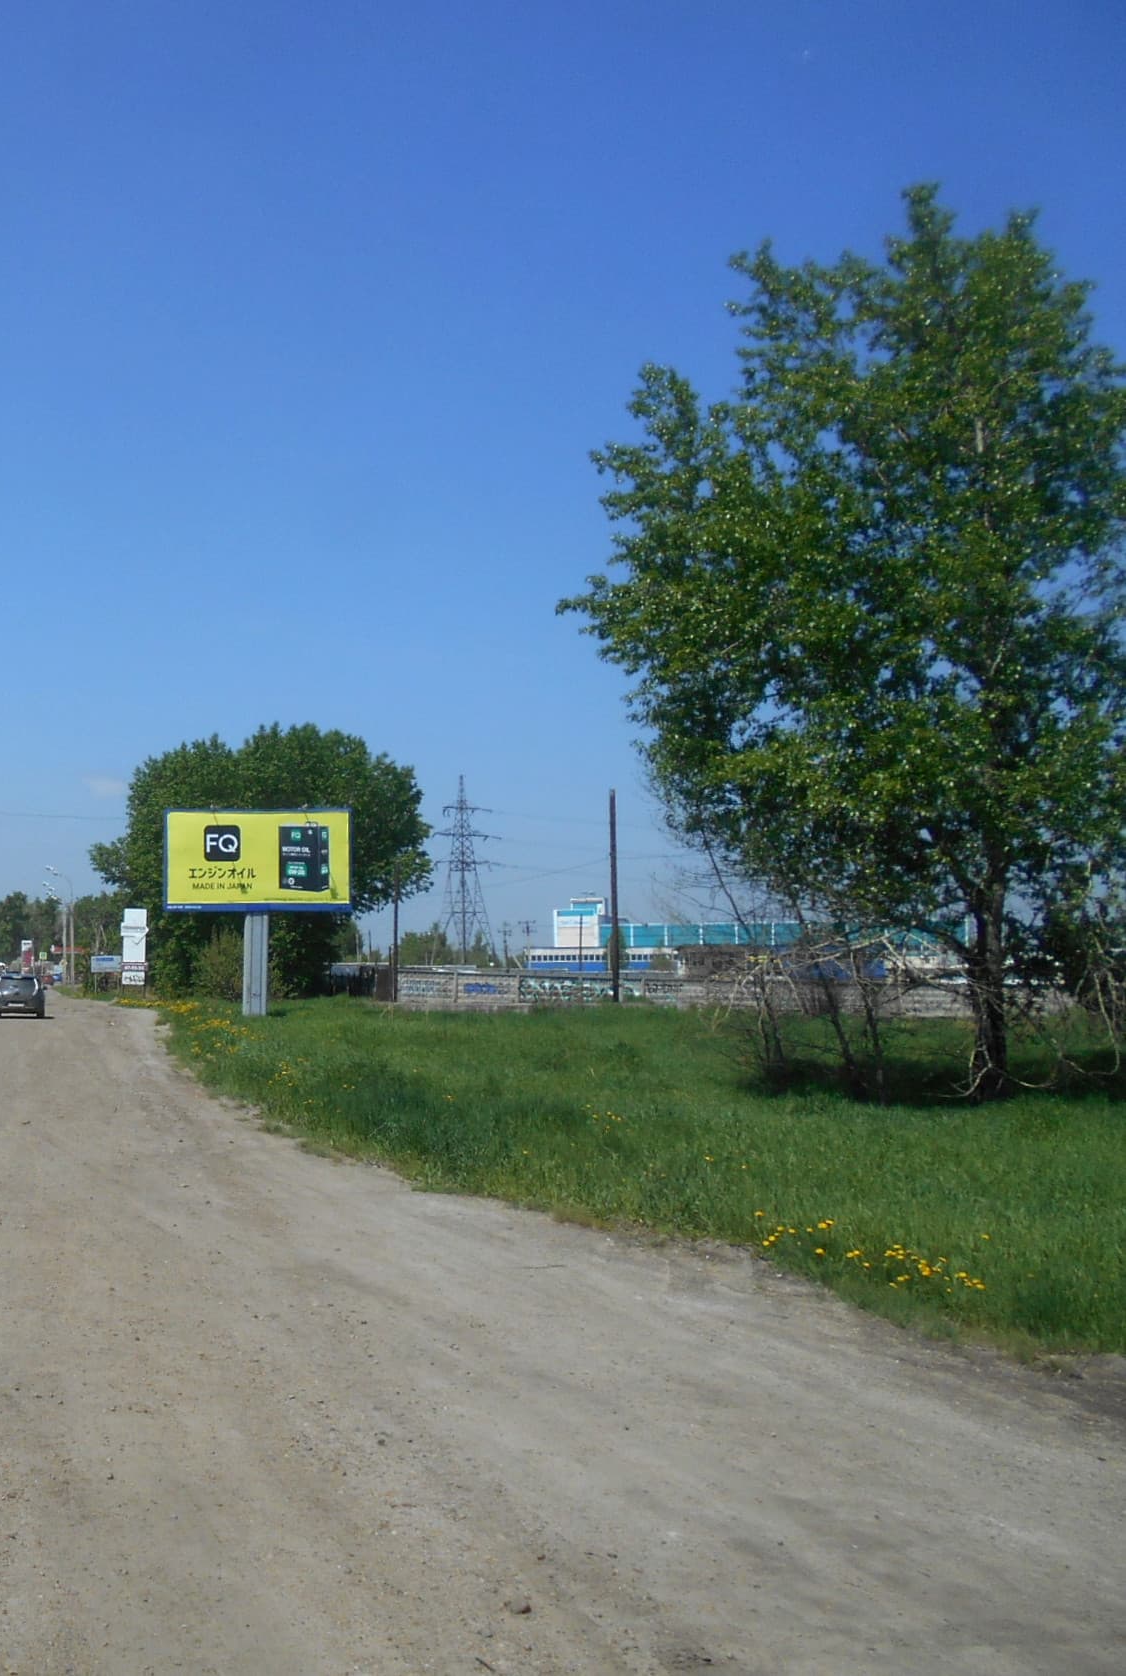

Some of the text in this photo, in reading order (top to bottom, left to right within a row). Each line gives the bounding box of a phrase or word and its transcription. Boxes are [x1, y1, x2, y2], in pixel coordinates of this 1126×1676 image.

[206, 834, 238, 853] FQ
[188, 866, 256, 879] エンジンオイル
